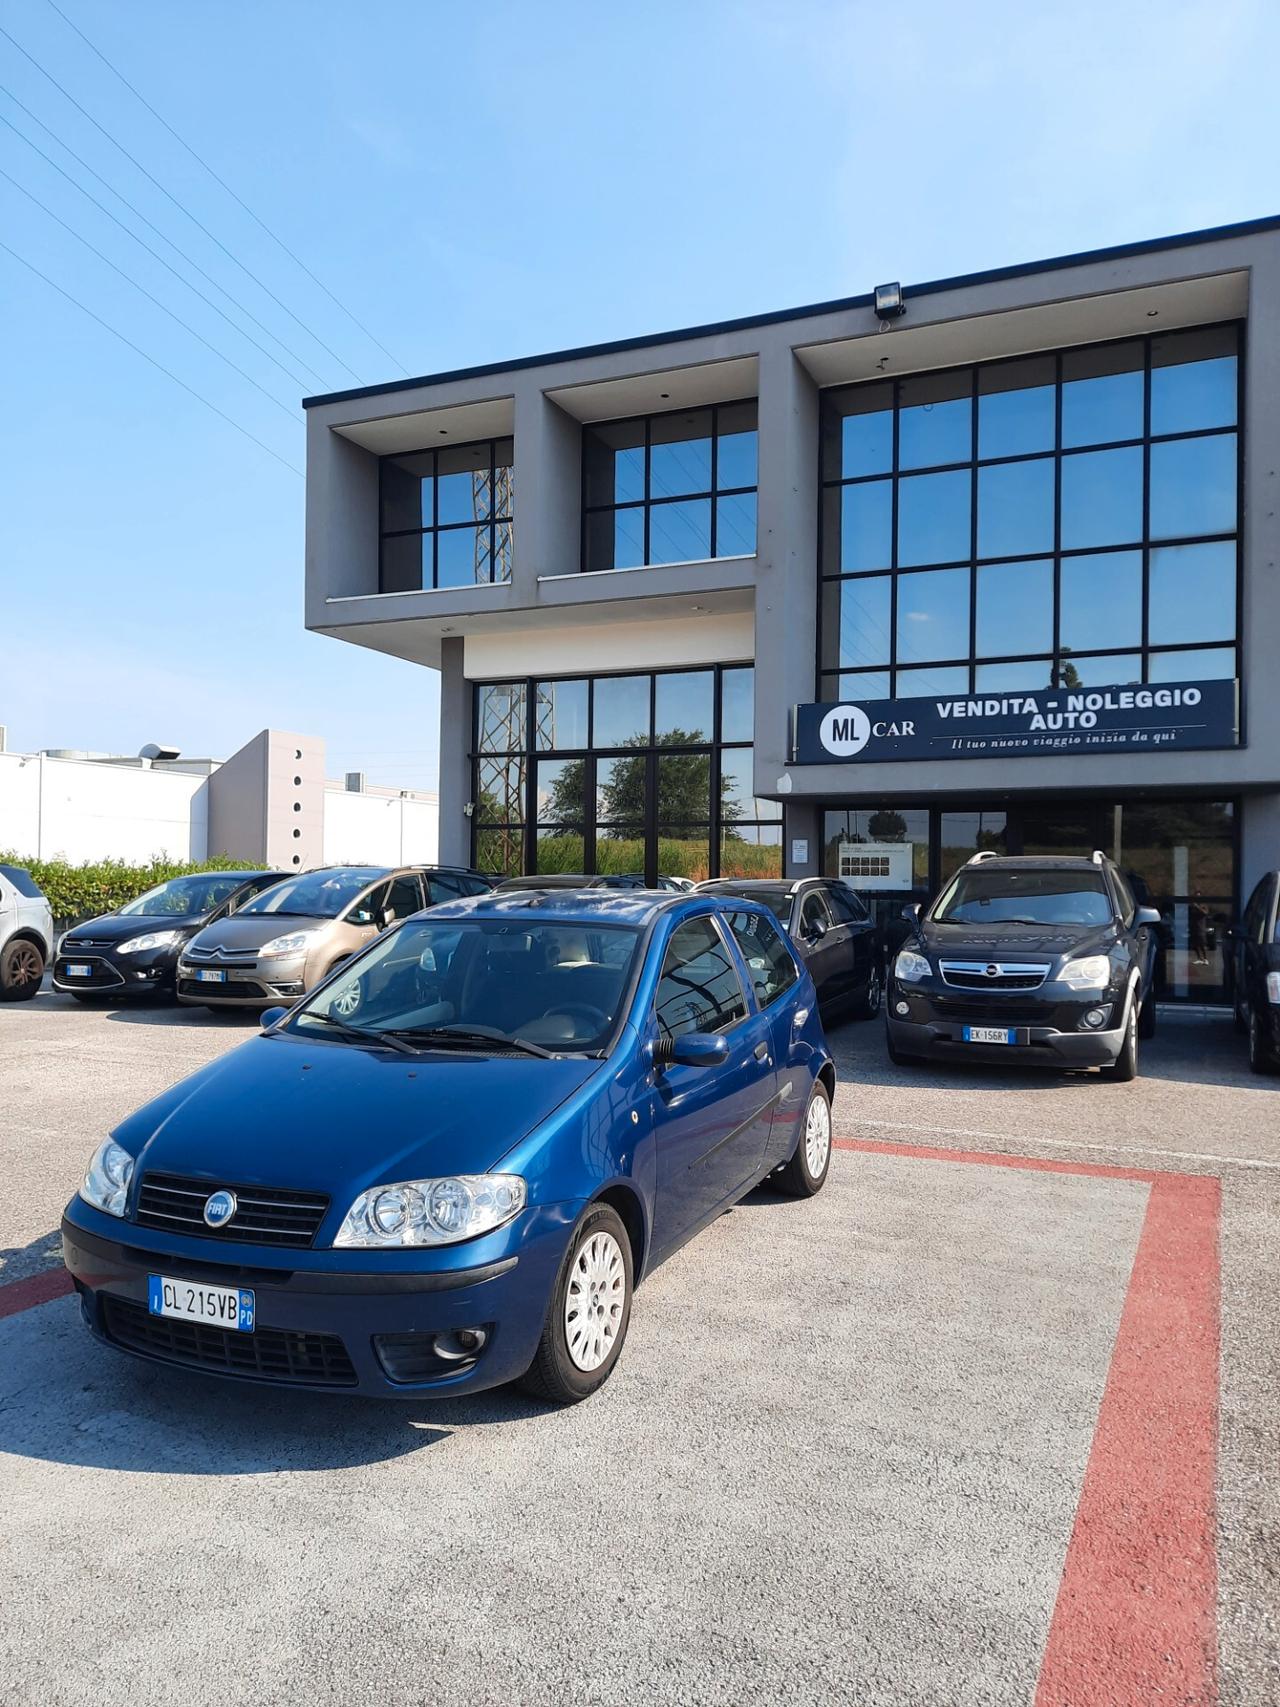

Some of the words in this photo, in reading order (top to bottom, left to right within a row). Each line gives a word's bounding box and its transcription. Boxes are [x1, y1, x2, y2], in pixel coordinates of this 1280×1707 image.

[936, 698, 1039, 718] VENDITA
[1067, 688, 1201, 711] NOLEGGIO
[832, 718, 860, 742] ML
[872, 721, 915, 737] CAR
[1029, 711, 1097, 730] AUTO
[952, 739, 963, 749] Il
[967, 739, 986, 748] tuo
[991, 739, 1028, 747] nuovo
[1033, 735, 1081, 747] viaggio
[1086, 733, 1127, 743] inizia
[1131, 731, 1148, 741] da
[207, 1202, 228, 1216] FIAT
[164, 1284, 181, 1310] CL
[186, 1289, 237, 1320] 215VB
[240, 1309, 253, 1325] PD
